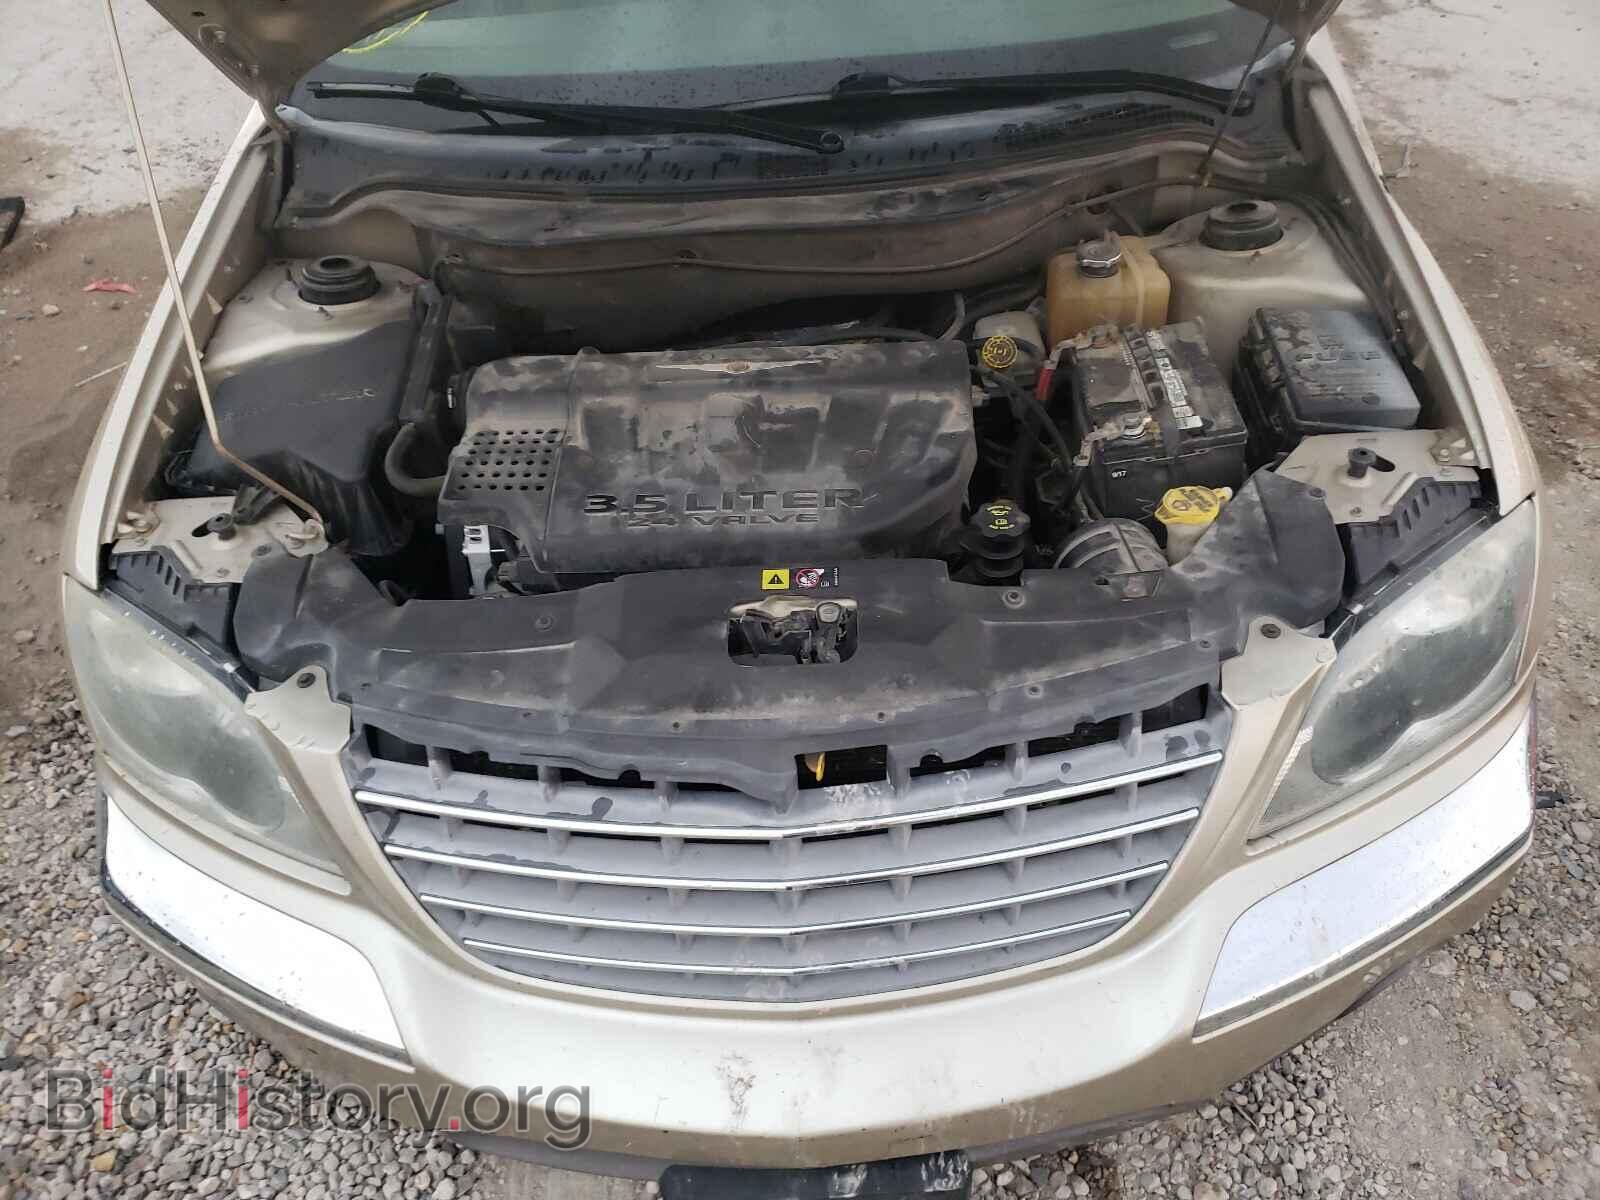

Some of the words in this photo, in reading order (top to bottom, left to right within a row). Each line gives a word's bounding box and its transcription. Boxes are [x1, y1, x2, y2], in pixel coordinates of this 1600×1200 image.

[583, 492, 668, 515] 3.5
[684, 487, 865, 512] LITER
[686, 511, 820, 527] VALVE
